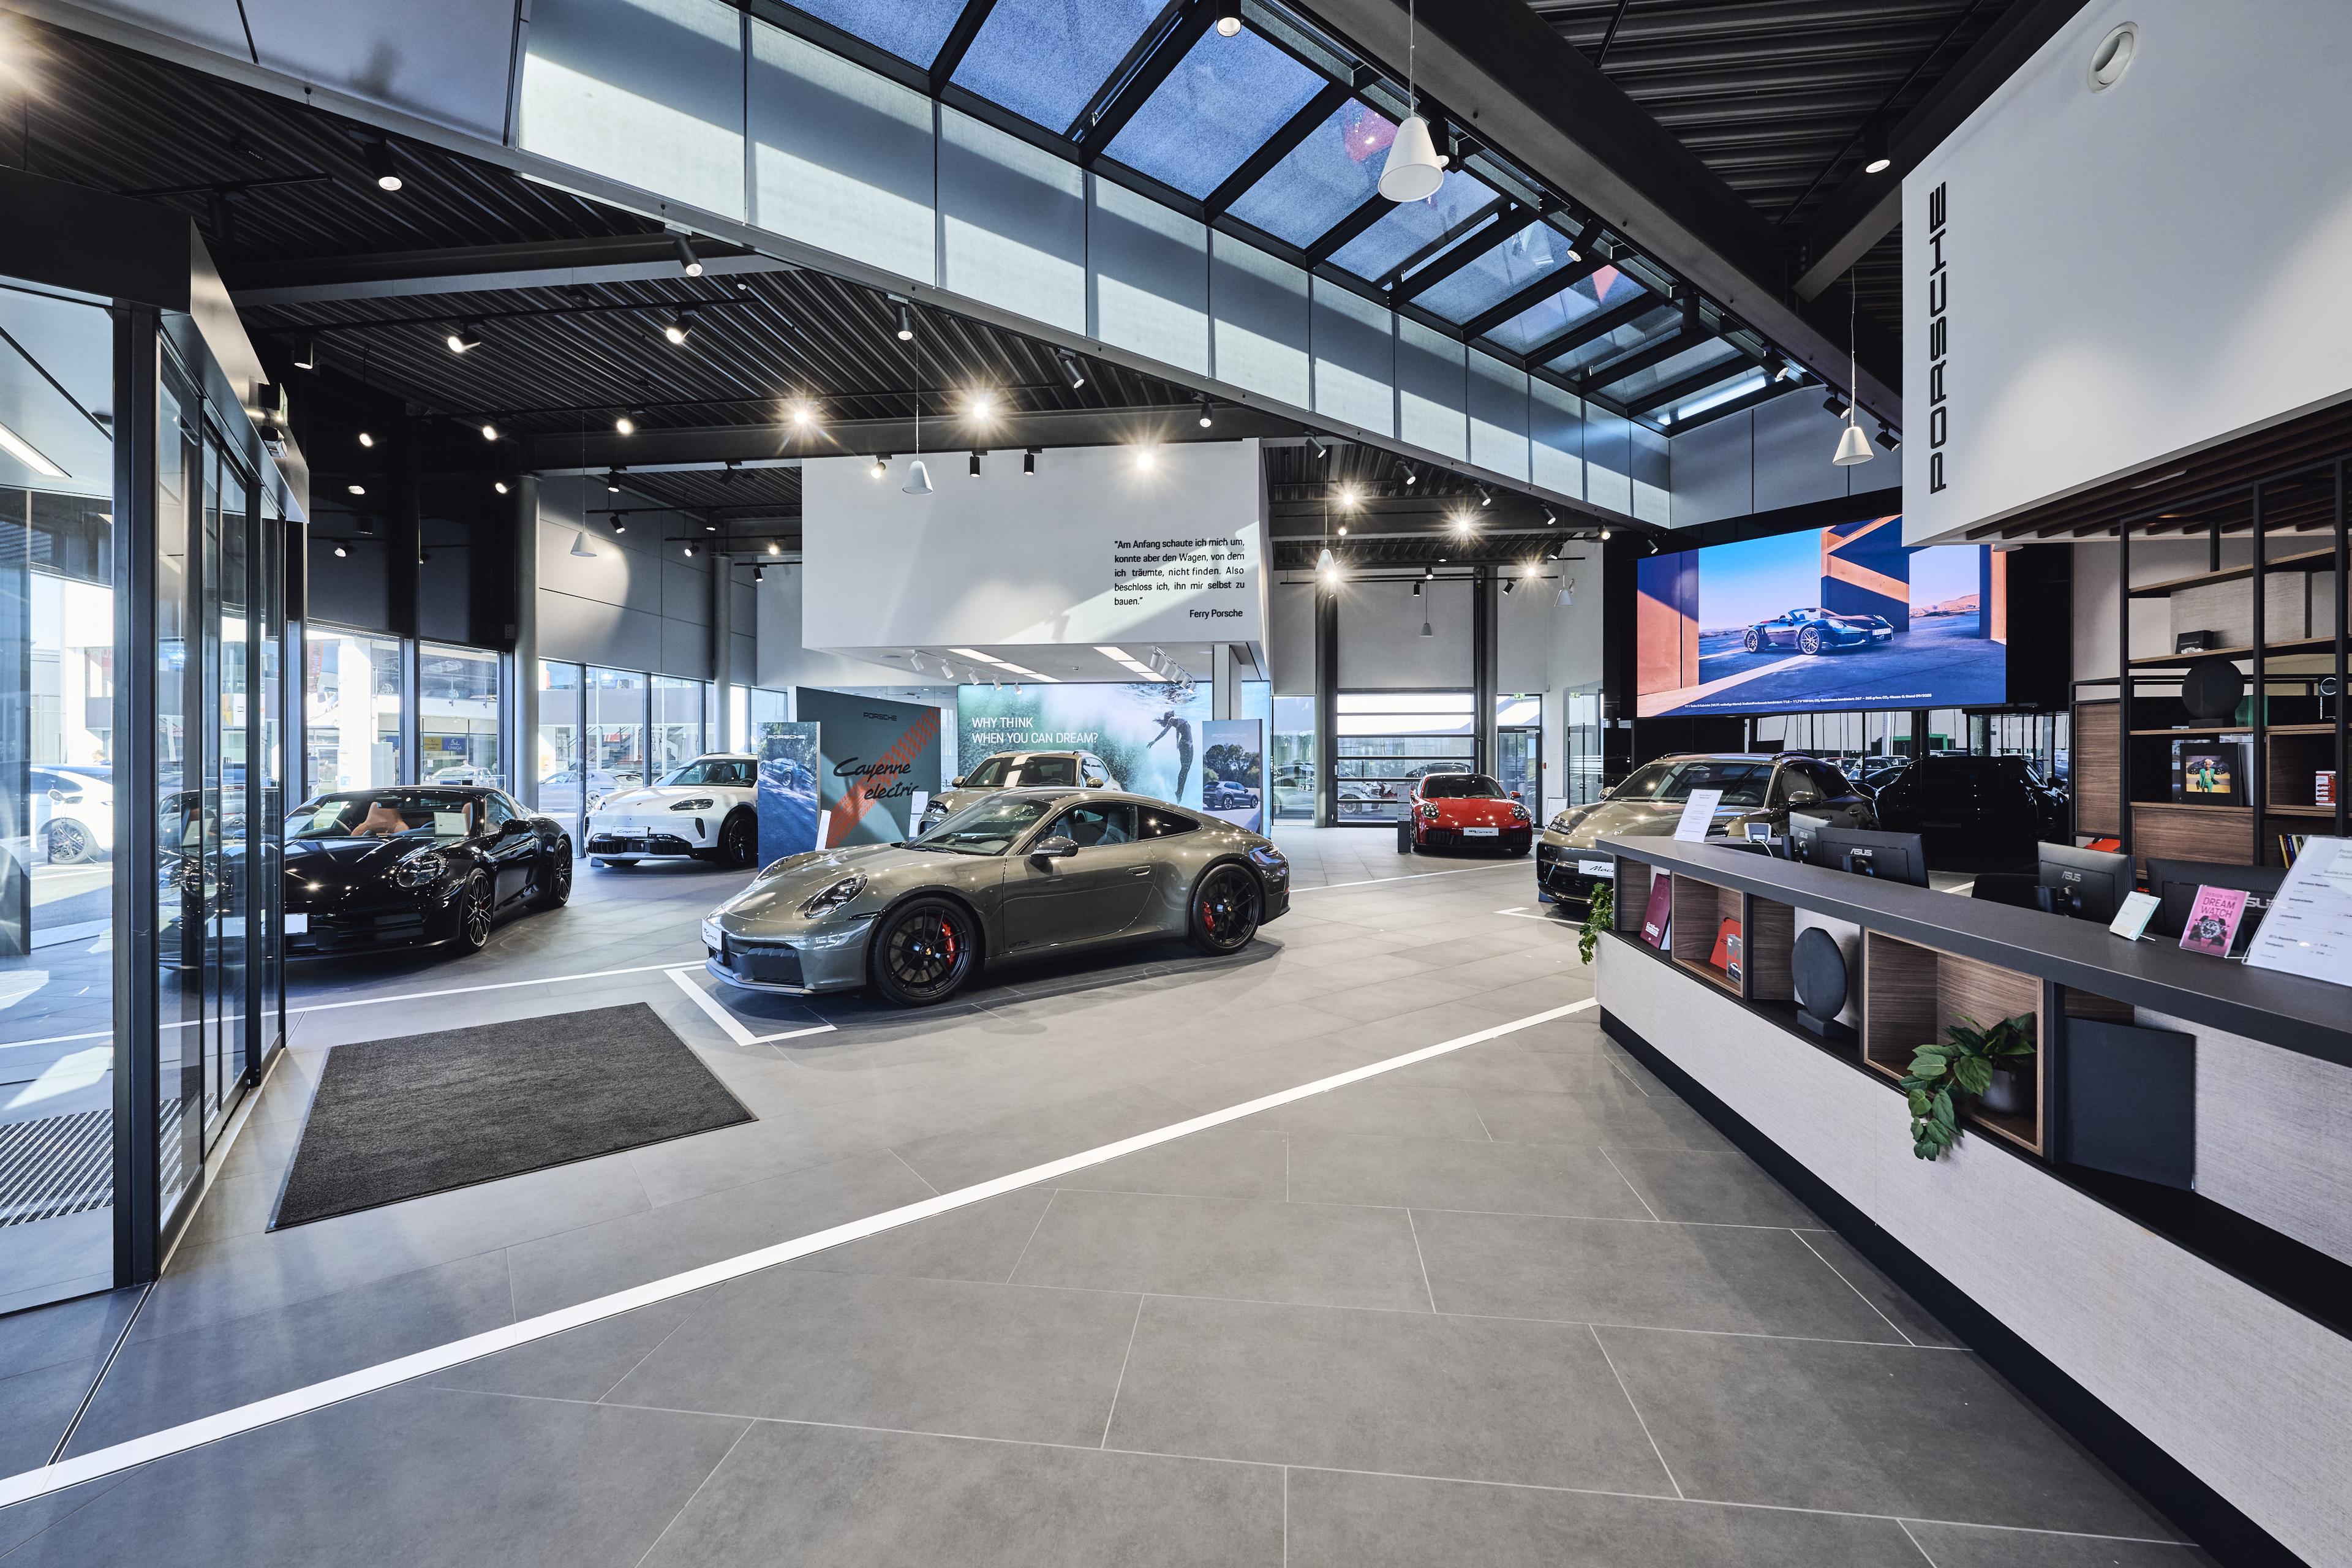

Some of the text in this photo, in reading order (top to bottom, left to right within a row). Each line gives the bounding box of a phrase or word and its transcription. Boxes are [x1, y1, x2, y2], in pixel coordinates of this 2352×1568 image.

[1930, 181, 1947, 494] PORSCHE
[1115, 540, 1131, 549] "Am
[1133, 540, 1161, 549] Anfang
[1208, 538, 1228, 547] mich
[1230, 539, 1245, 548] um,
[1115, 554, 1141, 563] konnte
[1179, 553, 1208, 563] Wagen,
[1227, 552, 1245, 560] dem
[1132, 568, 1164, 577] träumte,
[1168, 567, 1189, 576] nicht
[1192, 567, 1221, 575] finden.
[1226, 566, 1244, 575] Also
[1156, 582, 1170, 591] ich,
[1174, 581, 1186, 590] ihn
[1207, 581, 1232, 589] selbst
[1189, 609, 1243, 619] Ferry Porsche
[864, 712, 897, 721] PORSCHE
[971, 717, 1033, 728] WHY THINK
[971, 733, 1099, 743] WHEN YOU CAN DREAM?
[833, 757, 911, 782] Cayenne
[864, 782, 919, 800] electric
[1850, 848, 1872, 856] ASUS
[2062, 870, 2081, 882] ASUS
[2203, 897, 2236, 910] DREAM
[2201, 906, 2233, 918] WATCH
[1008, 940, 1030, 948] GTS
